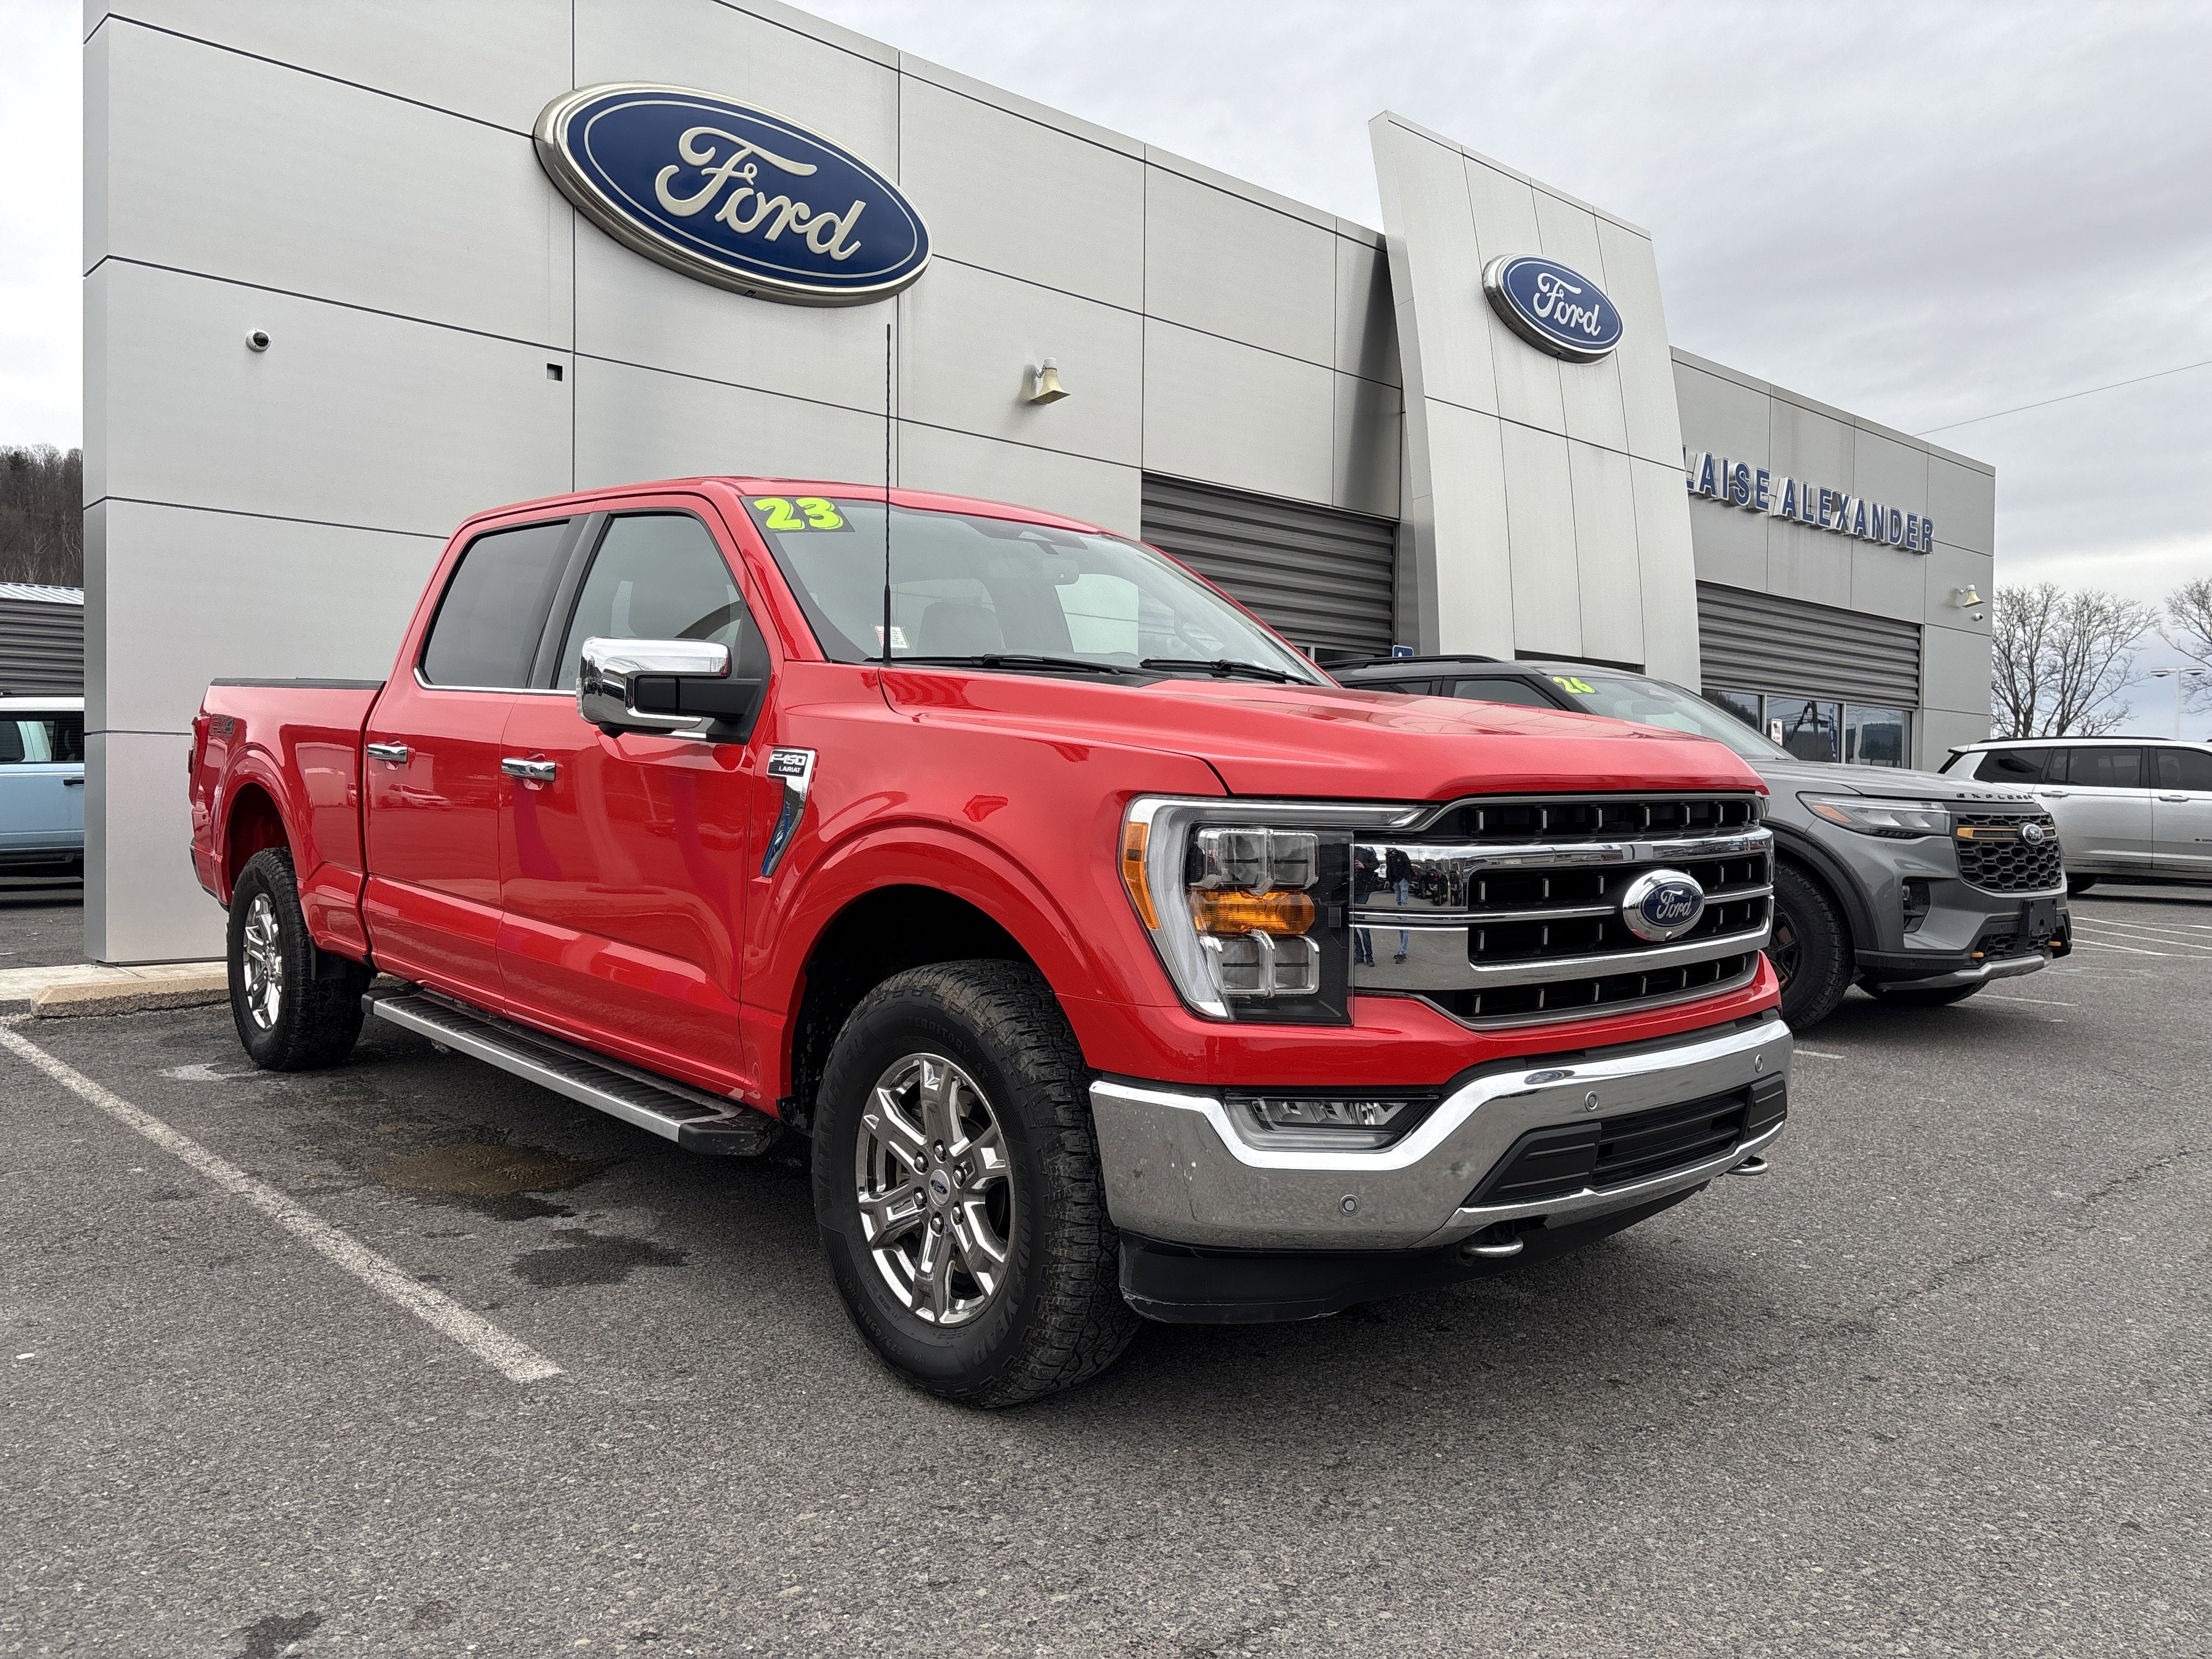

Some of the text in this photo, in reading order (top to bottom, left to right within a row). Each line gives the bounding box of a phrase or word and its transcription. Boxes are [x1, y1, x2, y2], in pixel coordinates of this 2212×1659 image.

[654, 126, 866, 261] Ford
[1533, 273, 1601, 336] Ford
[753, 498, 844, 531] 23
[1781, 476, 1934, 554] ALEXANDER
[1552, 676, 1595, 693] 26
[770, 753, 806, 766] F-150
[1656, 889, 1692, 919] Ford
[907, 1015, 989, 1079] TERRITORY AT
[932, 1181, 944, 1193] Ford
